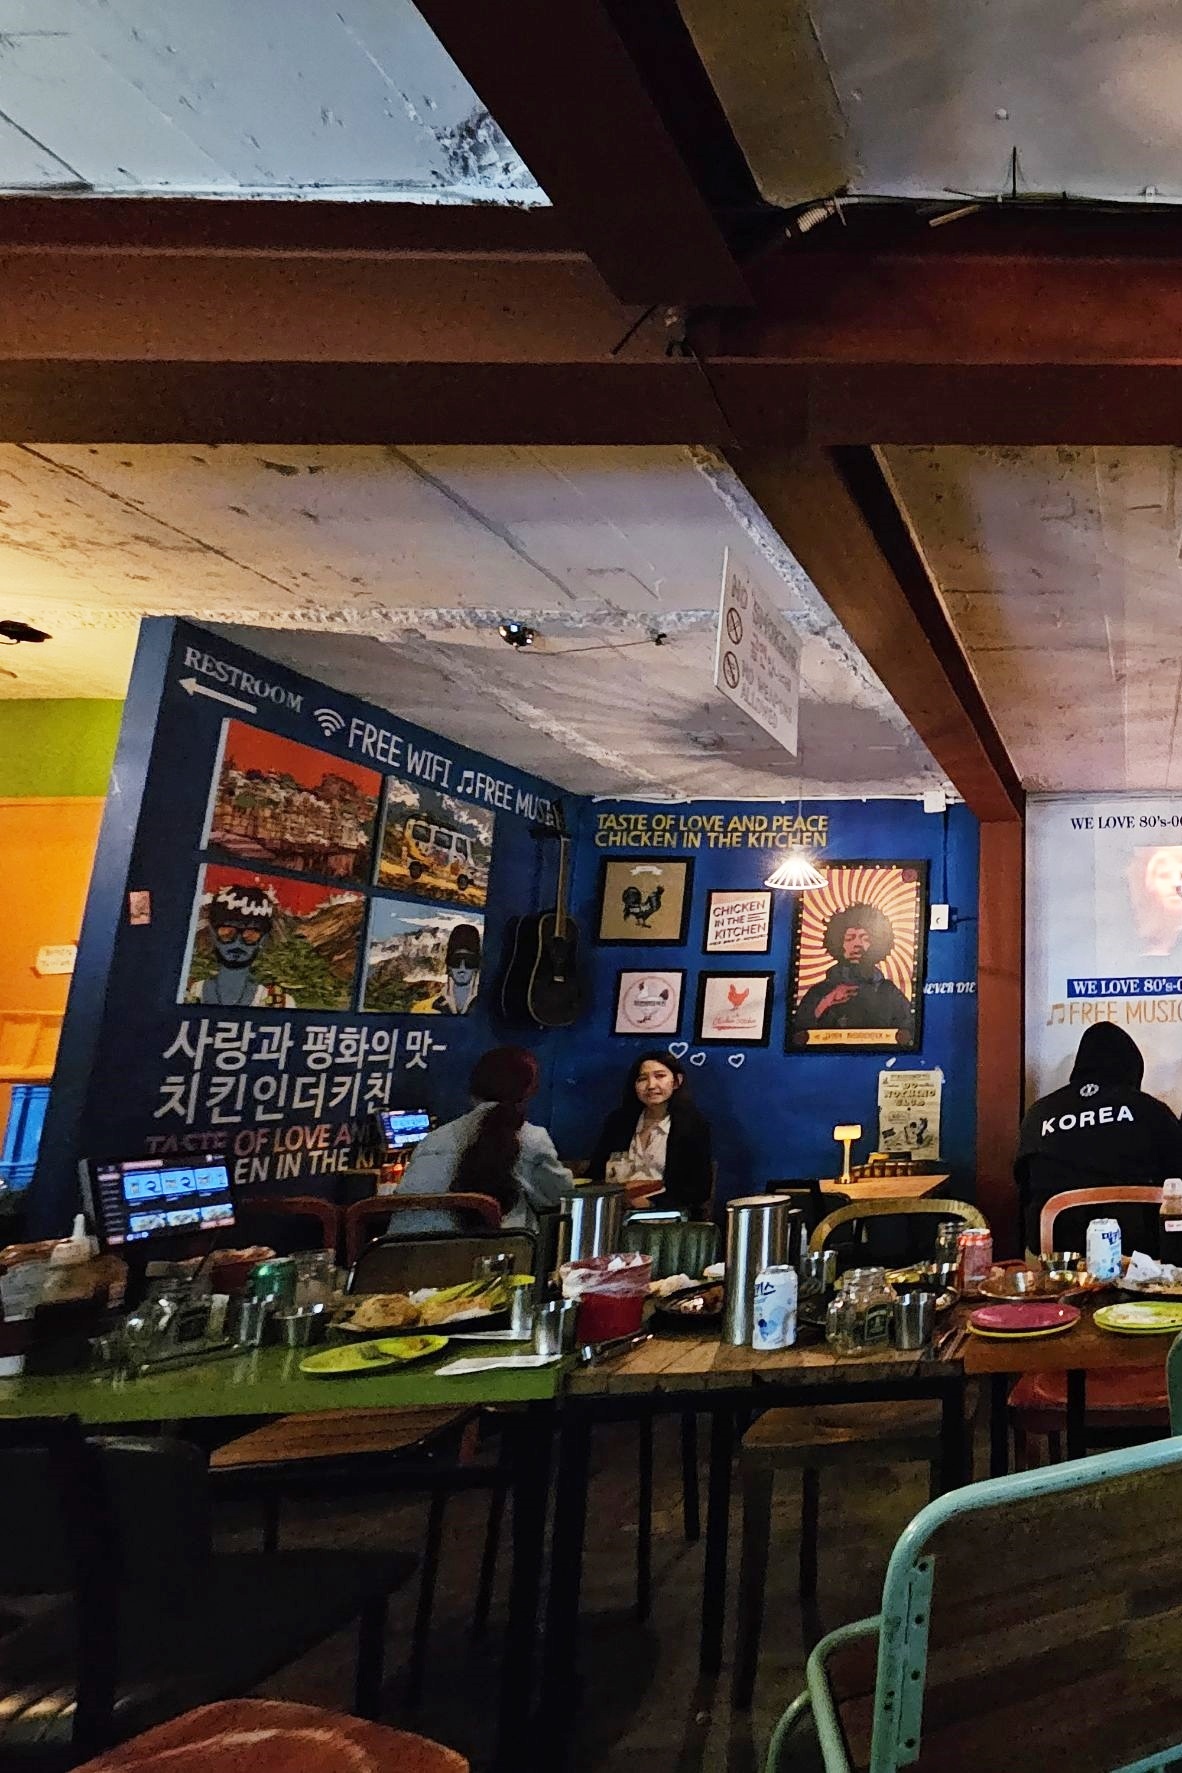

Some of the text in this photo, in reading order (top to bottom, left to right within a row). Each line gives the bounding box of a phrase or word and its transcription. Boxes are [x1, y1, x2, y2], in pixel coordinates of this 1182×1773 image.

[184, 646, 304, 713] RESTROOM
[348, 718, 453, 788] FREE WIFI
[474, 772, 514, 811] FREE
[596, 814, 829, 832] TASTE OF LOVE AND PEACE
[1070, 817, 1094, 830] WE
[1098, 816, 1136, 829] LOVE
[594, 831, 828, 848] CHICKEN IN THE KITCHEN
[713, 900, 766, 917] CHICKEN
[714, 915, 745, 928] IN THE
[715, 922, 767, 939] KITCHEN
[1072, 980, 1098, 995] WE
[1100, 979, 1140, 995] LOVE
[1069, 1001, 1118, 1025] FREE
[162, 1018, 295, 1071] 사랑과
[302, 1025, 398, 1070] 평화의
[153, 1072, 393, 1125] 치킨인더키친
[1041, 1105, 1134, 1136] KOREA
[233, 1126, 271, 1157] OF
[273, 1122, 333, 1152] LOVE
[275, 1150, 302, 1180] IN
[308, 1148, 350, 1176] THE
